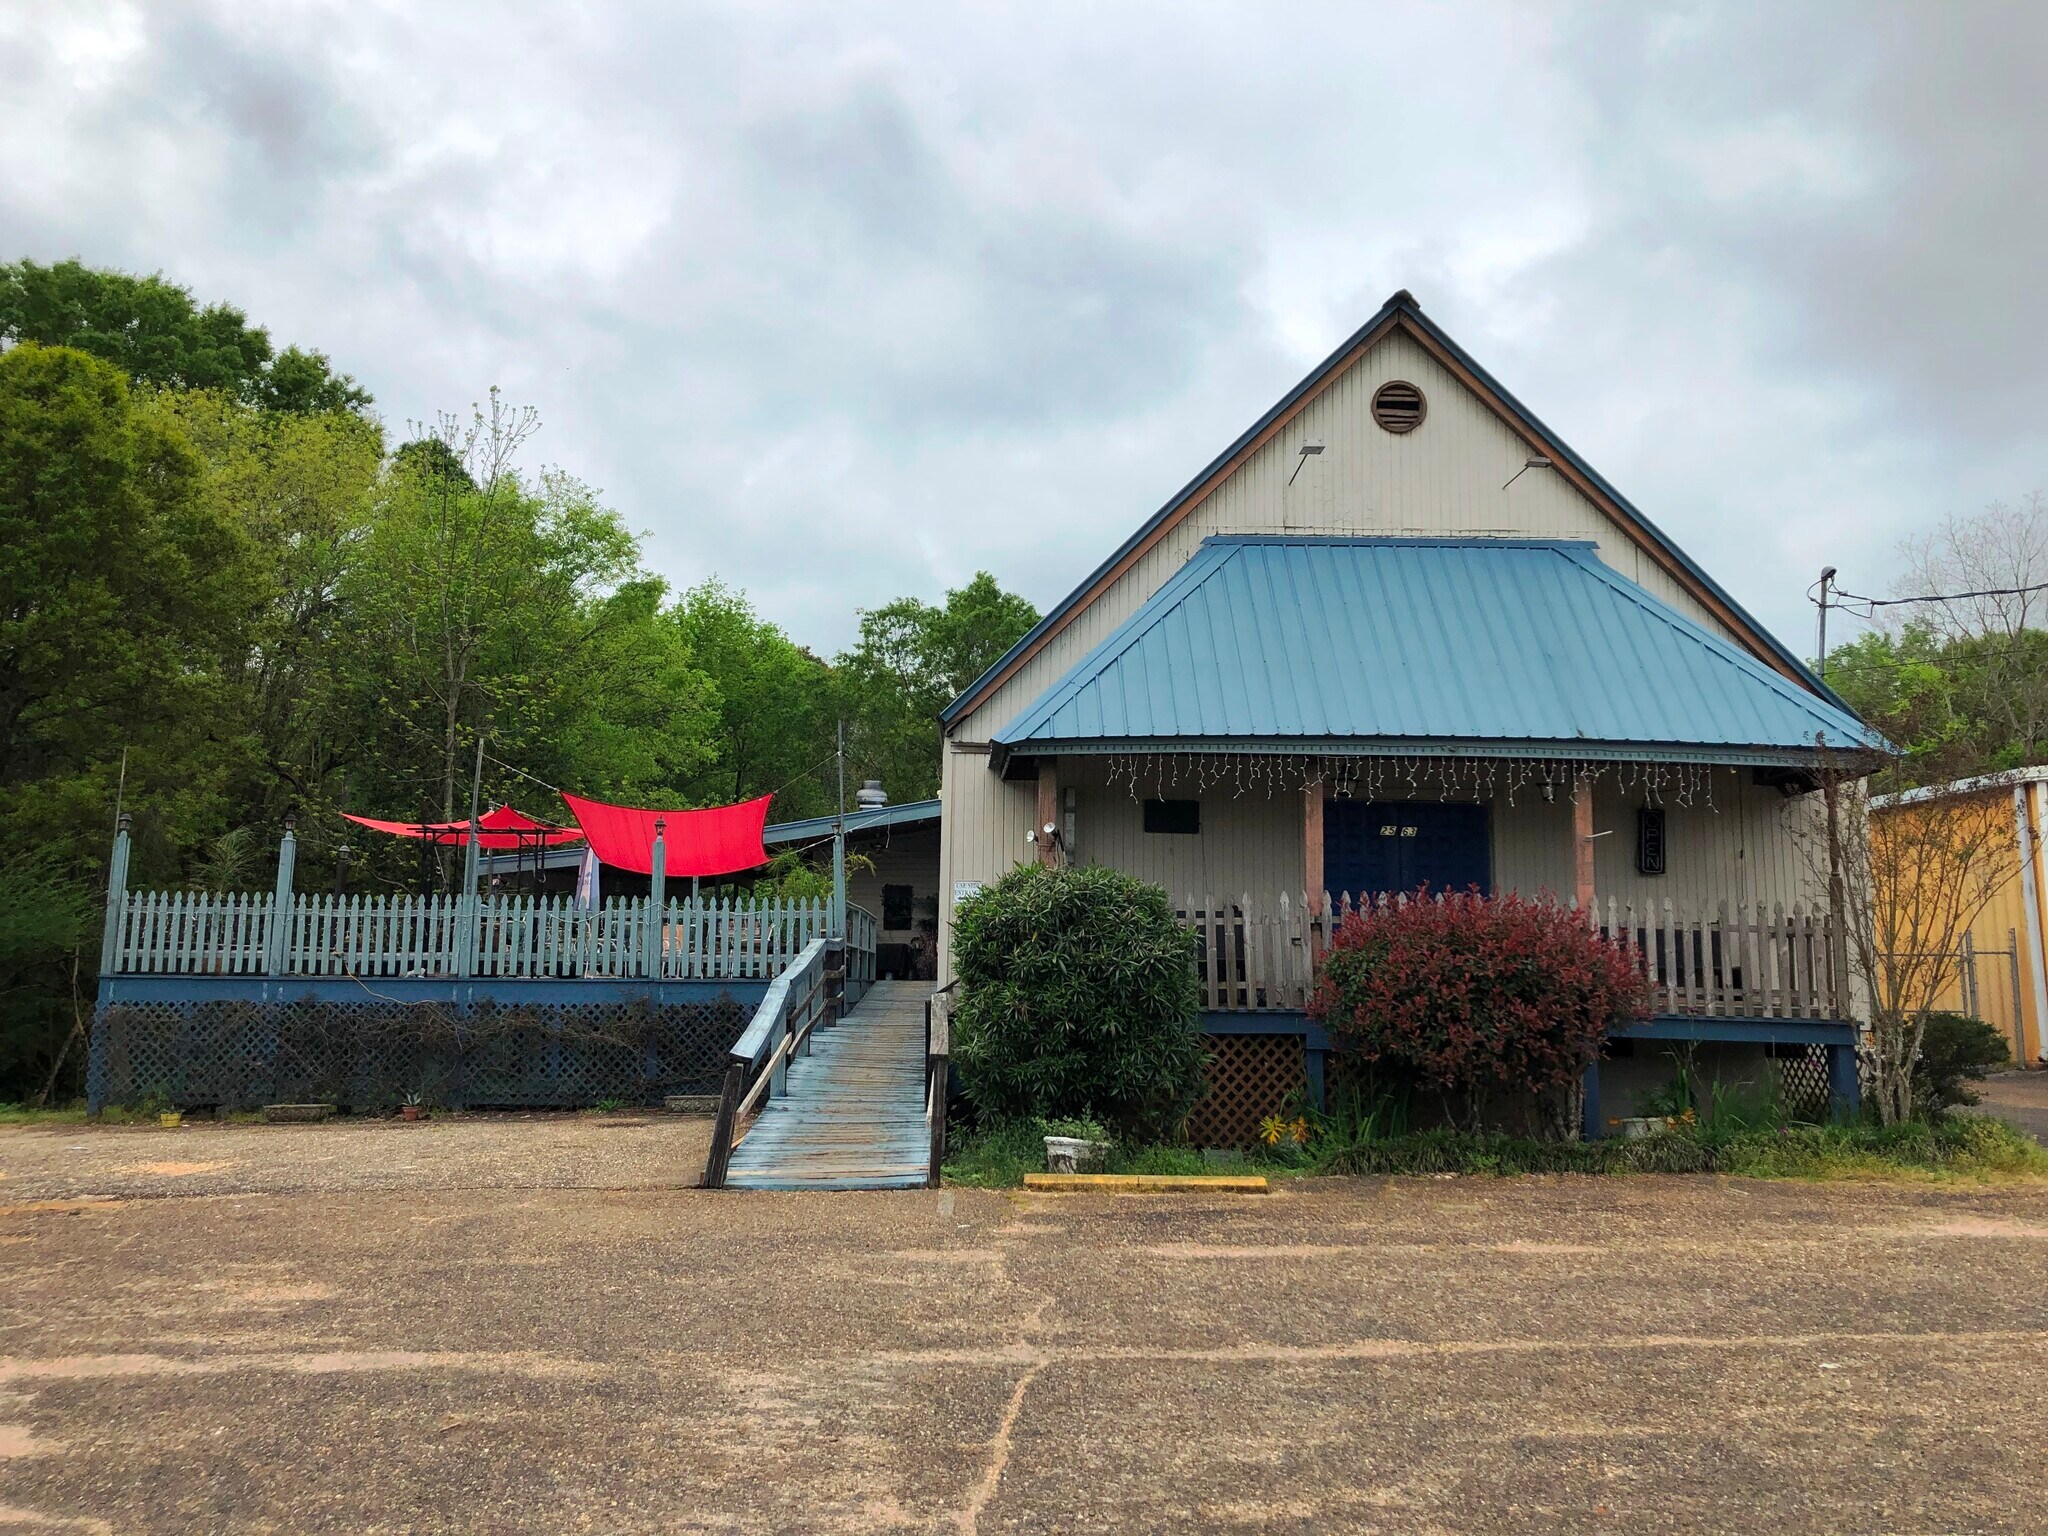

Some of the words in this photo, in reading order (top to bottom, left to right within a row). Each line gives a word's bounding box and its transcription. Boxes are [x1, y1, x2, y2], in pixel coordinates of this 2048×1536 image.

[1381, 826, 1395, 835] 25
[1402, 827, 1416, 836] 63
[1645, 814, 1660, 870] OPEN
